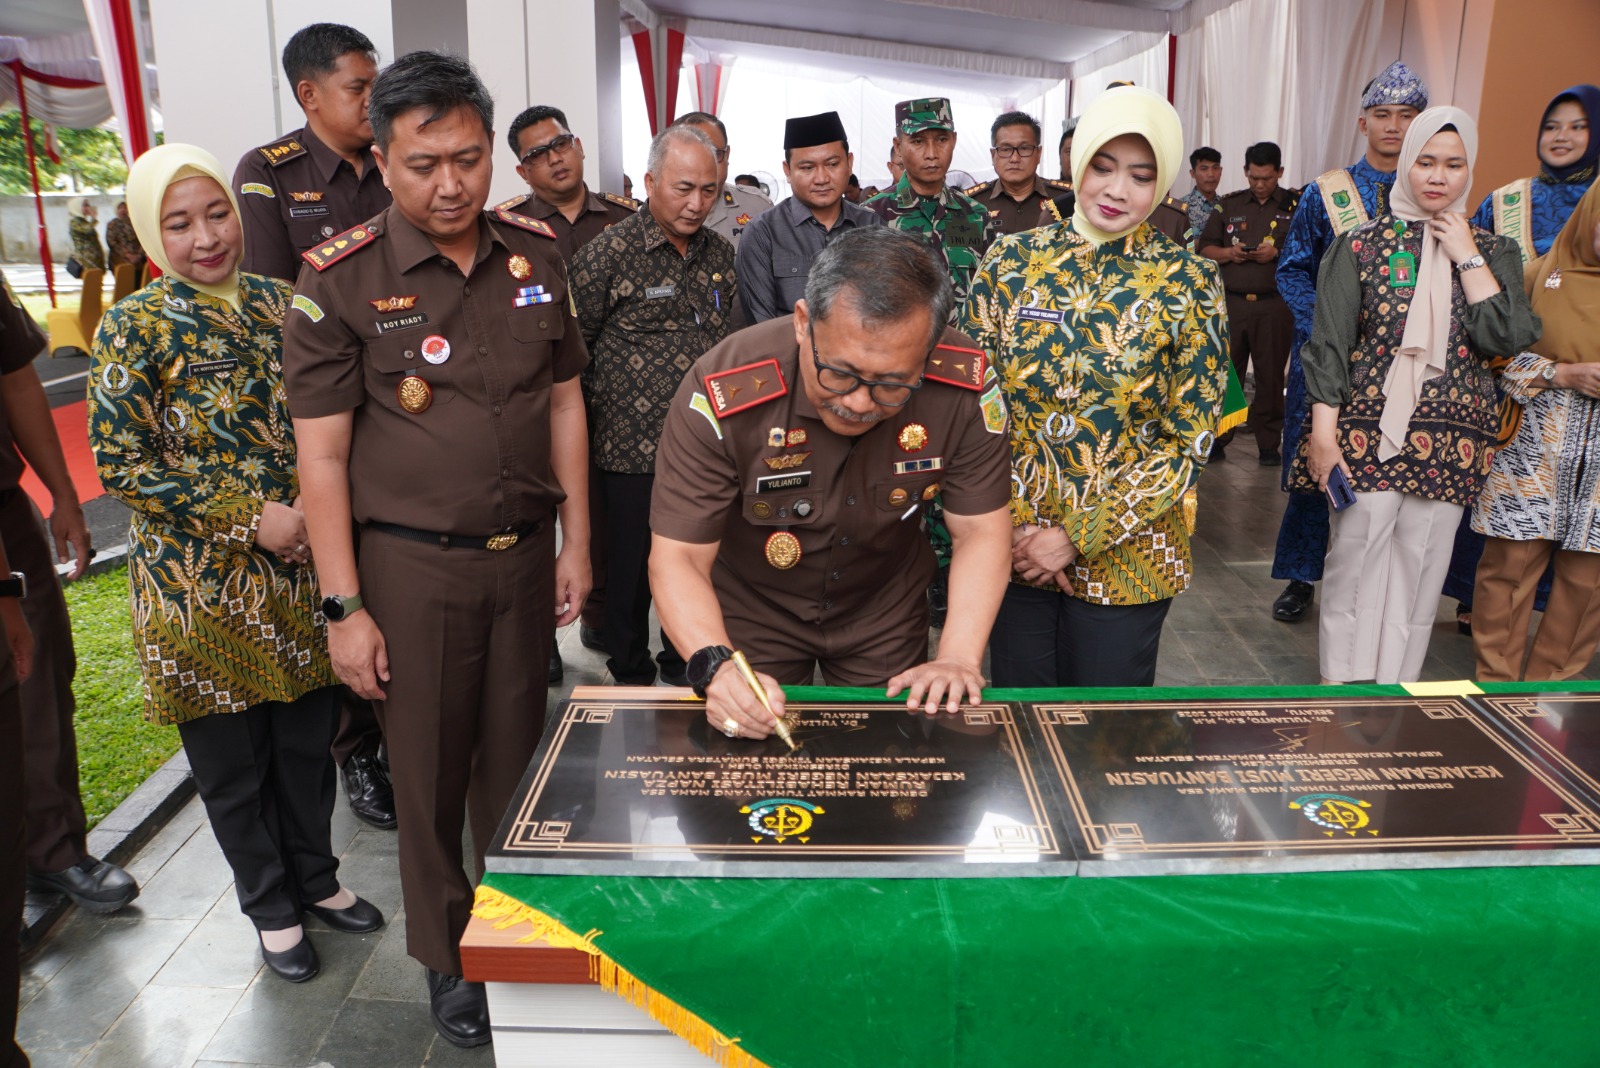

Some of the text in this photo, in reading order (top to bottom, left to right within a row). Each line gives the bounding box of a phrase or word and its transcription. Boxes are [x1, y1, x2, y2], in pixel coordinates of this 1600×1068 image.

[307, 252, 324, 266] JAKSA
[383, 316, 422, 329] ROY RIADY
[972, 357, 982, 384] JAKSA
[710, 380, 726, 411] JAKSA
[768, 477, 801, 488] YULIANTO
[604, 770, 715, 779] BANYUASIN
[778, 772, 849, 780] NEGERI
[856, 772, 965, 780] KEJAKSAAN
[1105, 766, 1503, 785] KEJAKSAAN NEGERI MUSI BANYUASIN
[644, 780, 925, 789] RUMAH REHABILITASI NAPZA
[757, 789, 804, 797] TUHAN
[1177, 787, 1203, 795] ESA
